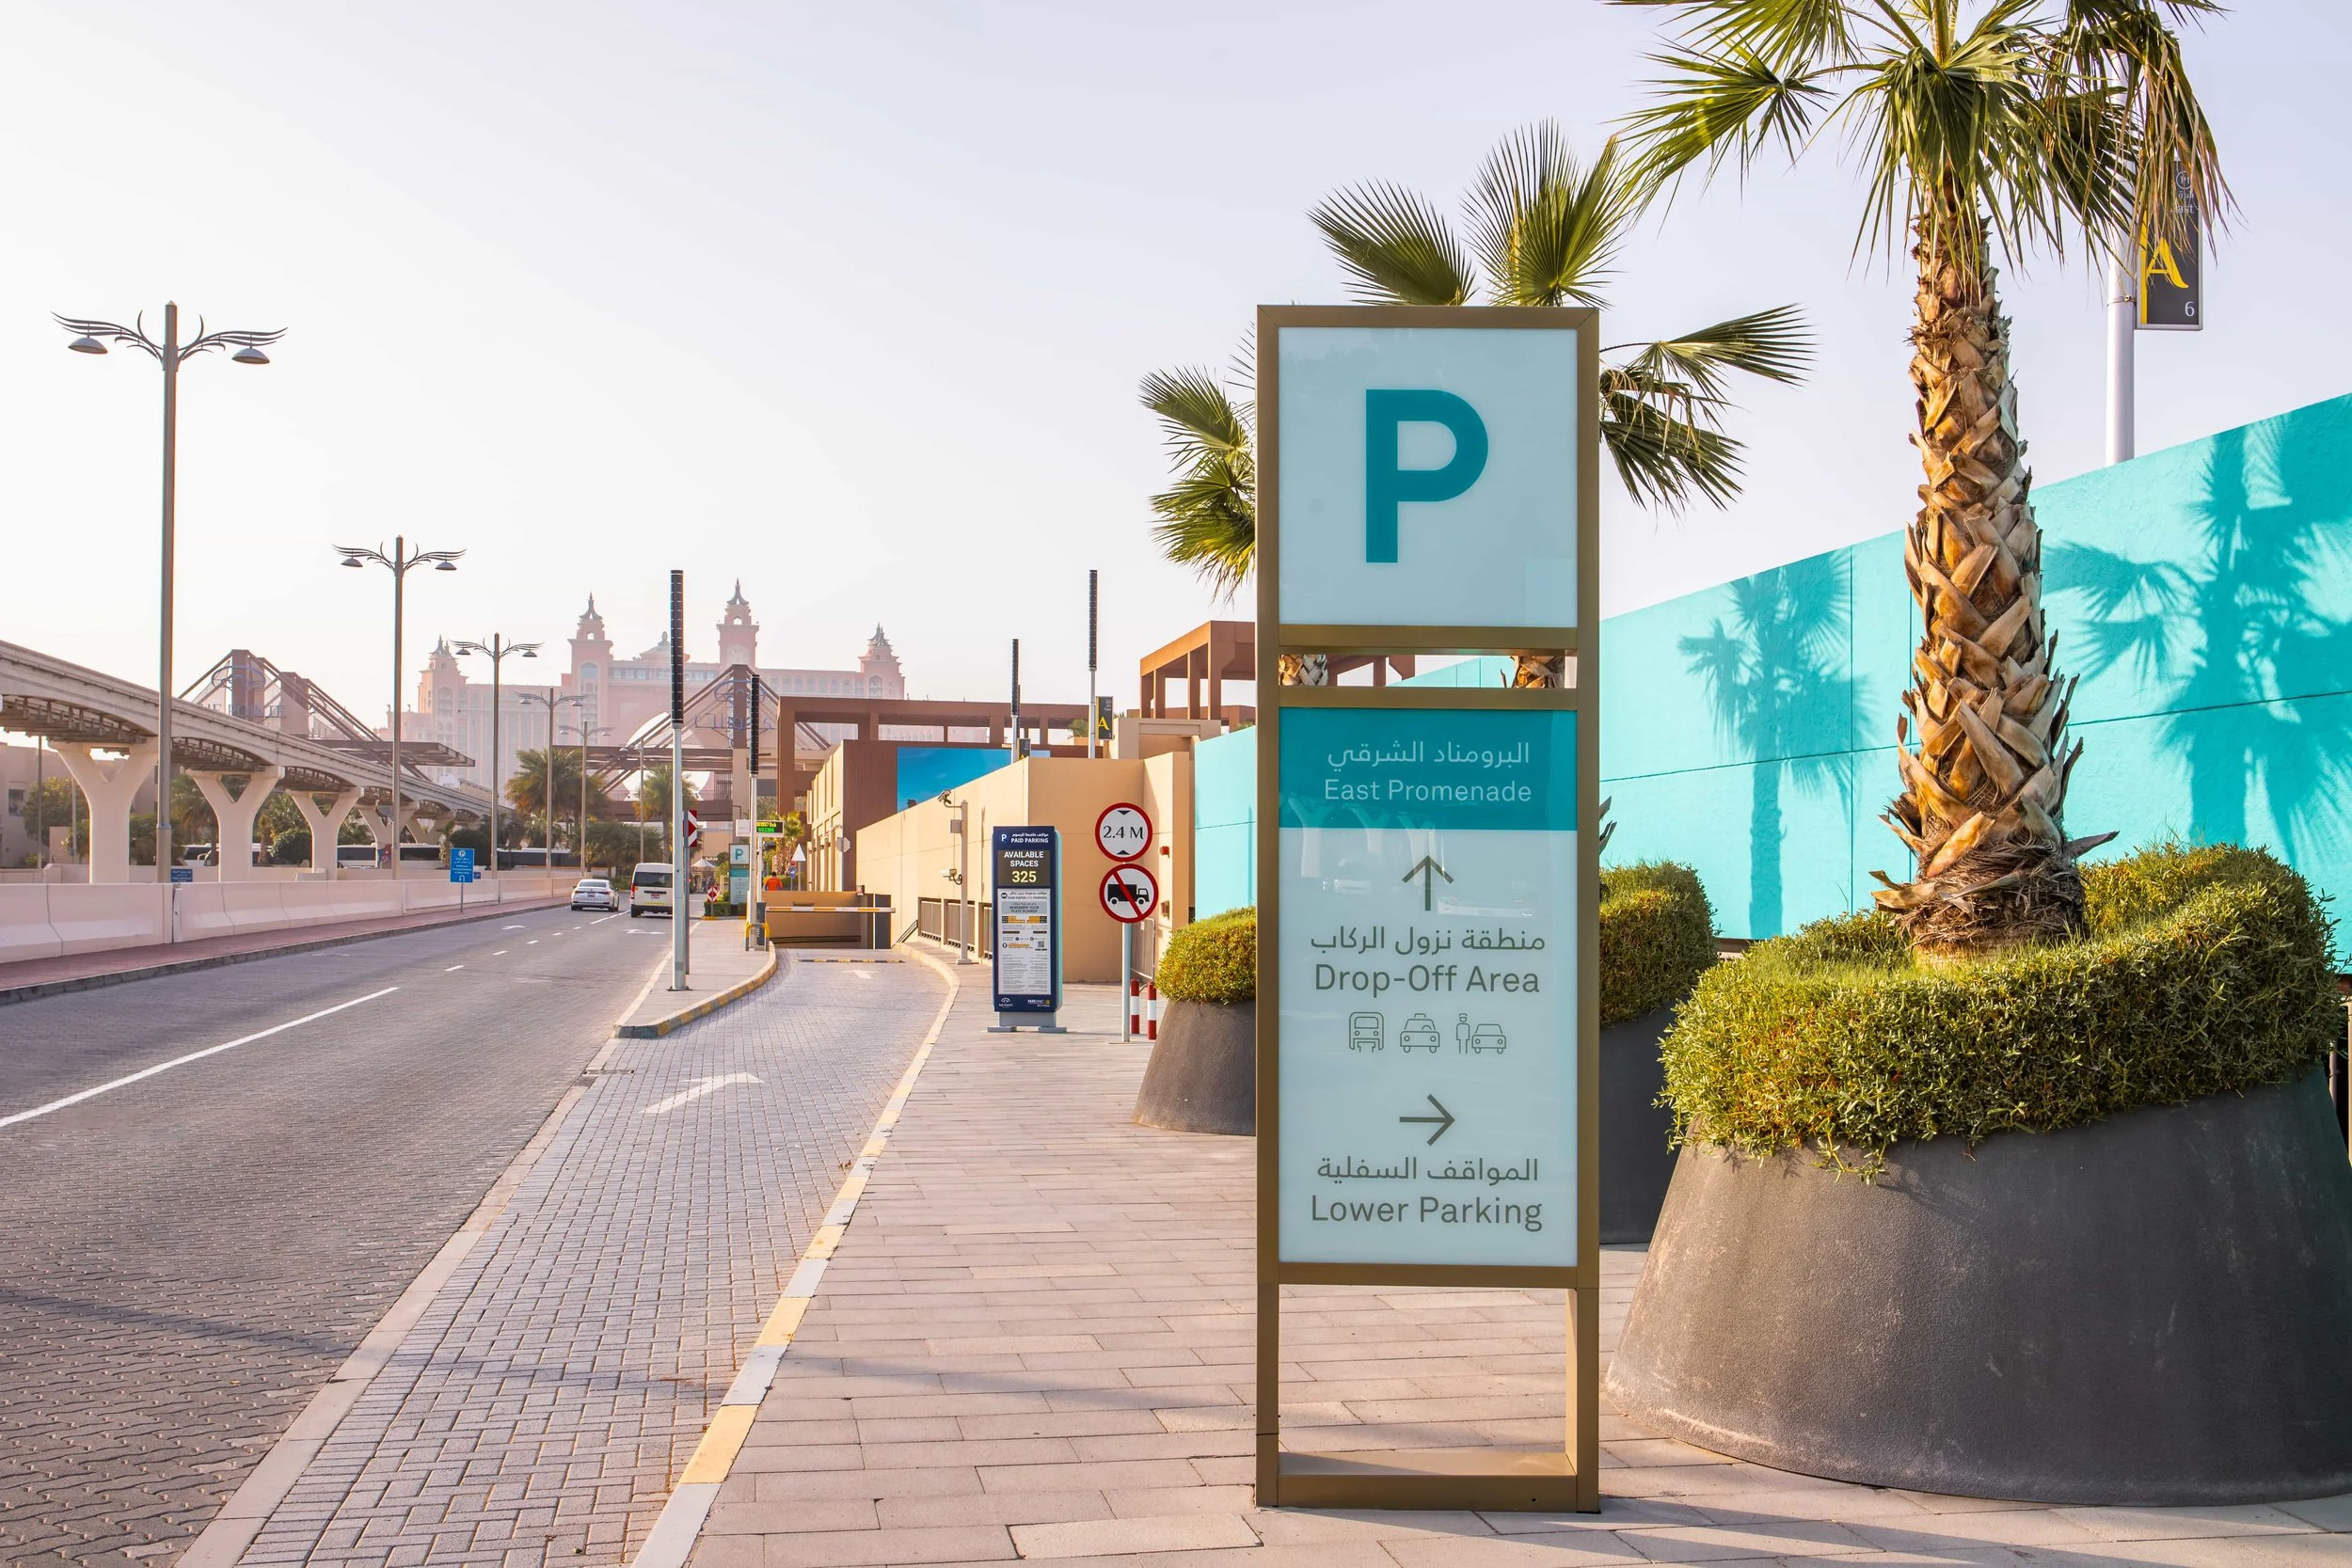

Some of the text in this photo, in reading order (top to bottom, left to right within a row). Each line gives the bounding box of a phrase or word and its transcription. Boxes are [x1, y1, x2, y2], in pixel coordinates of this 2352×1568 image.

[2146, 237, 2188, 289] A
[2185, 301, 2195, 317] 6
[1366, 389, 1488, 563] P
[1097, 716, 1110, 731] A
[1327, 739, 1530, 773] البرومناد الشرقي
[1324, 779, 1532, 801] East Promenade
[1001, 833, 1008, 842] P
[1103, 825, 1144, 840] 2.4 M
[735, 848, 744, 861] P
[1004, 850, 1044, 859] AVAILABLE
[1011, 870, 1037, 883] 325
[1311, 926, 1546, 956] منطقة نزول الركاب
[1315, 963, 1540, 999] Drop-Off Area
[1317, 1155, 1538, 1186] المواقف السفلية
[1311, 1195, 1543, 1232] Lower Parking
